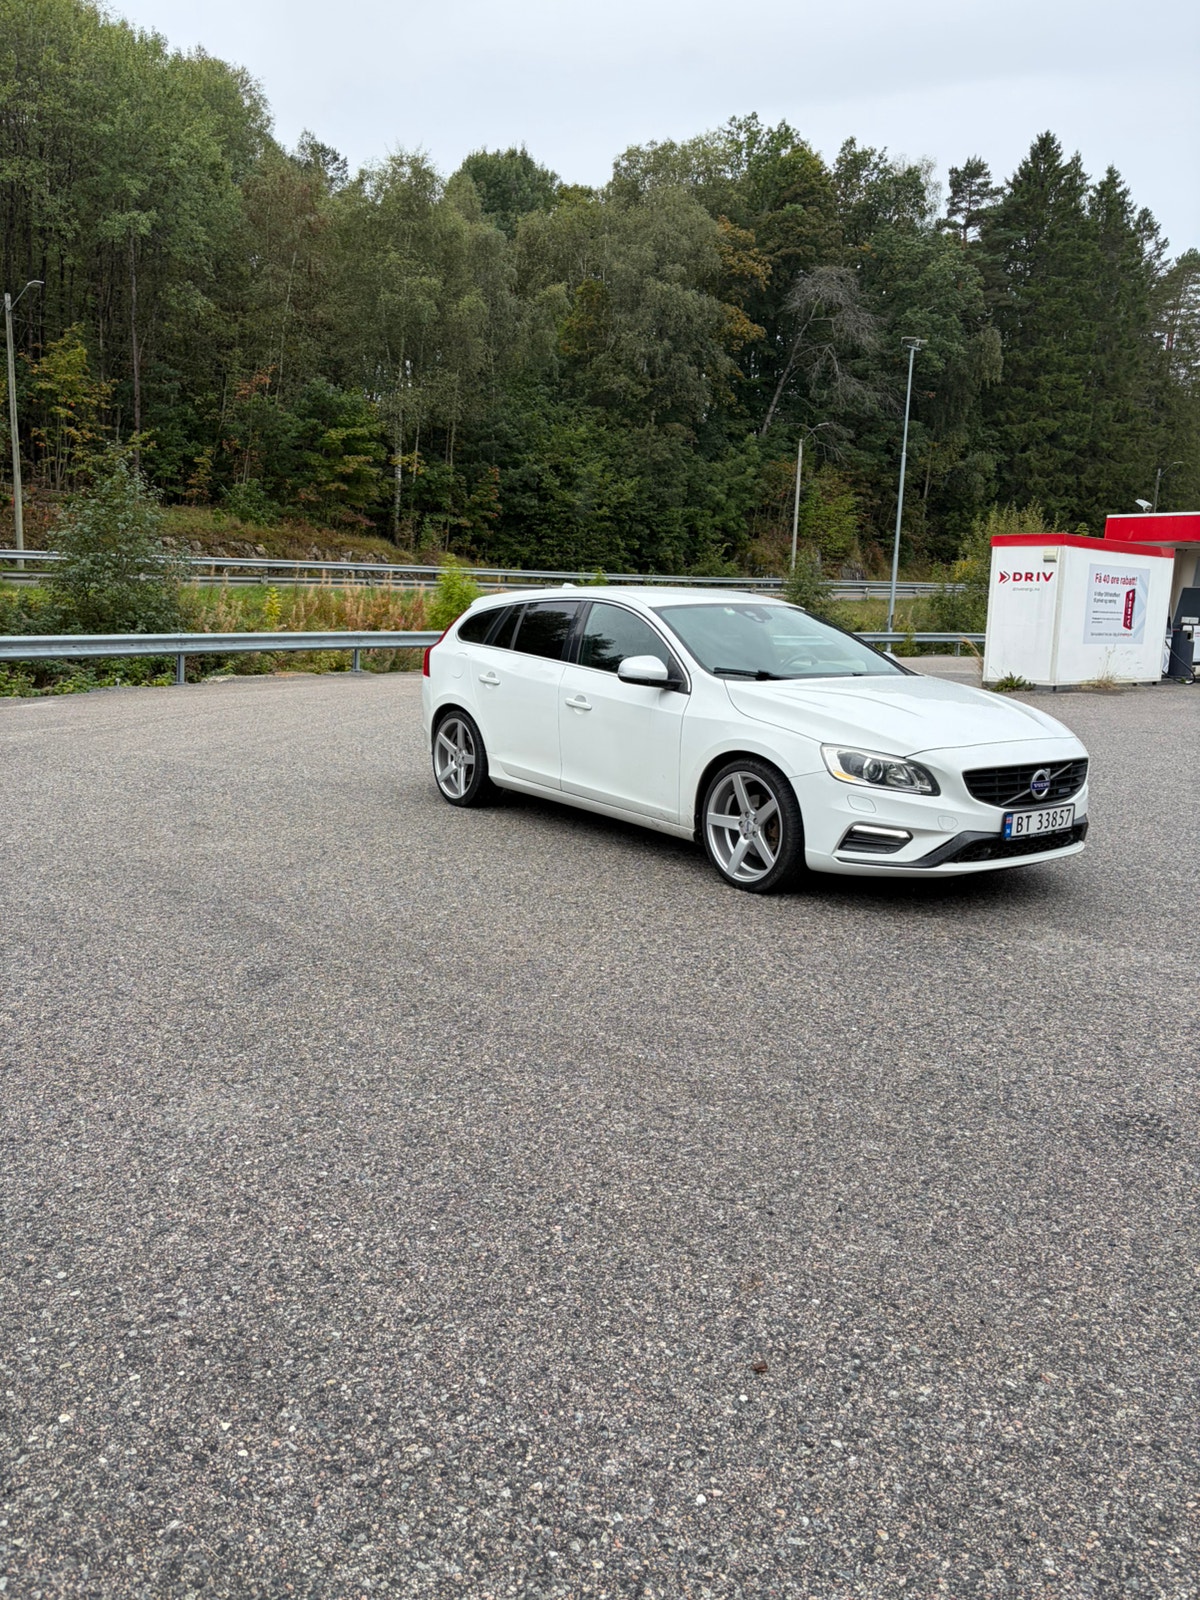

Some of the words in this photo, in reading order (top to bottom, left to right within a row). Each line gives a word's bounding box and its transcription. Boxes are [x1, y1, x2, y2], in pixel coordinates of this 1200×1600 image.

[1012, 571, 1054, 582] DRIV
[1095, 573, 1102, 583] Få
[1103, 574, 1110, 584] 40
[1016, 815, 1032, 834] BT
[1037, 808, 1071, 831] 33857
